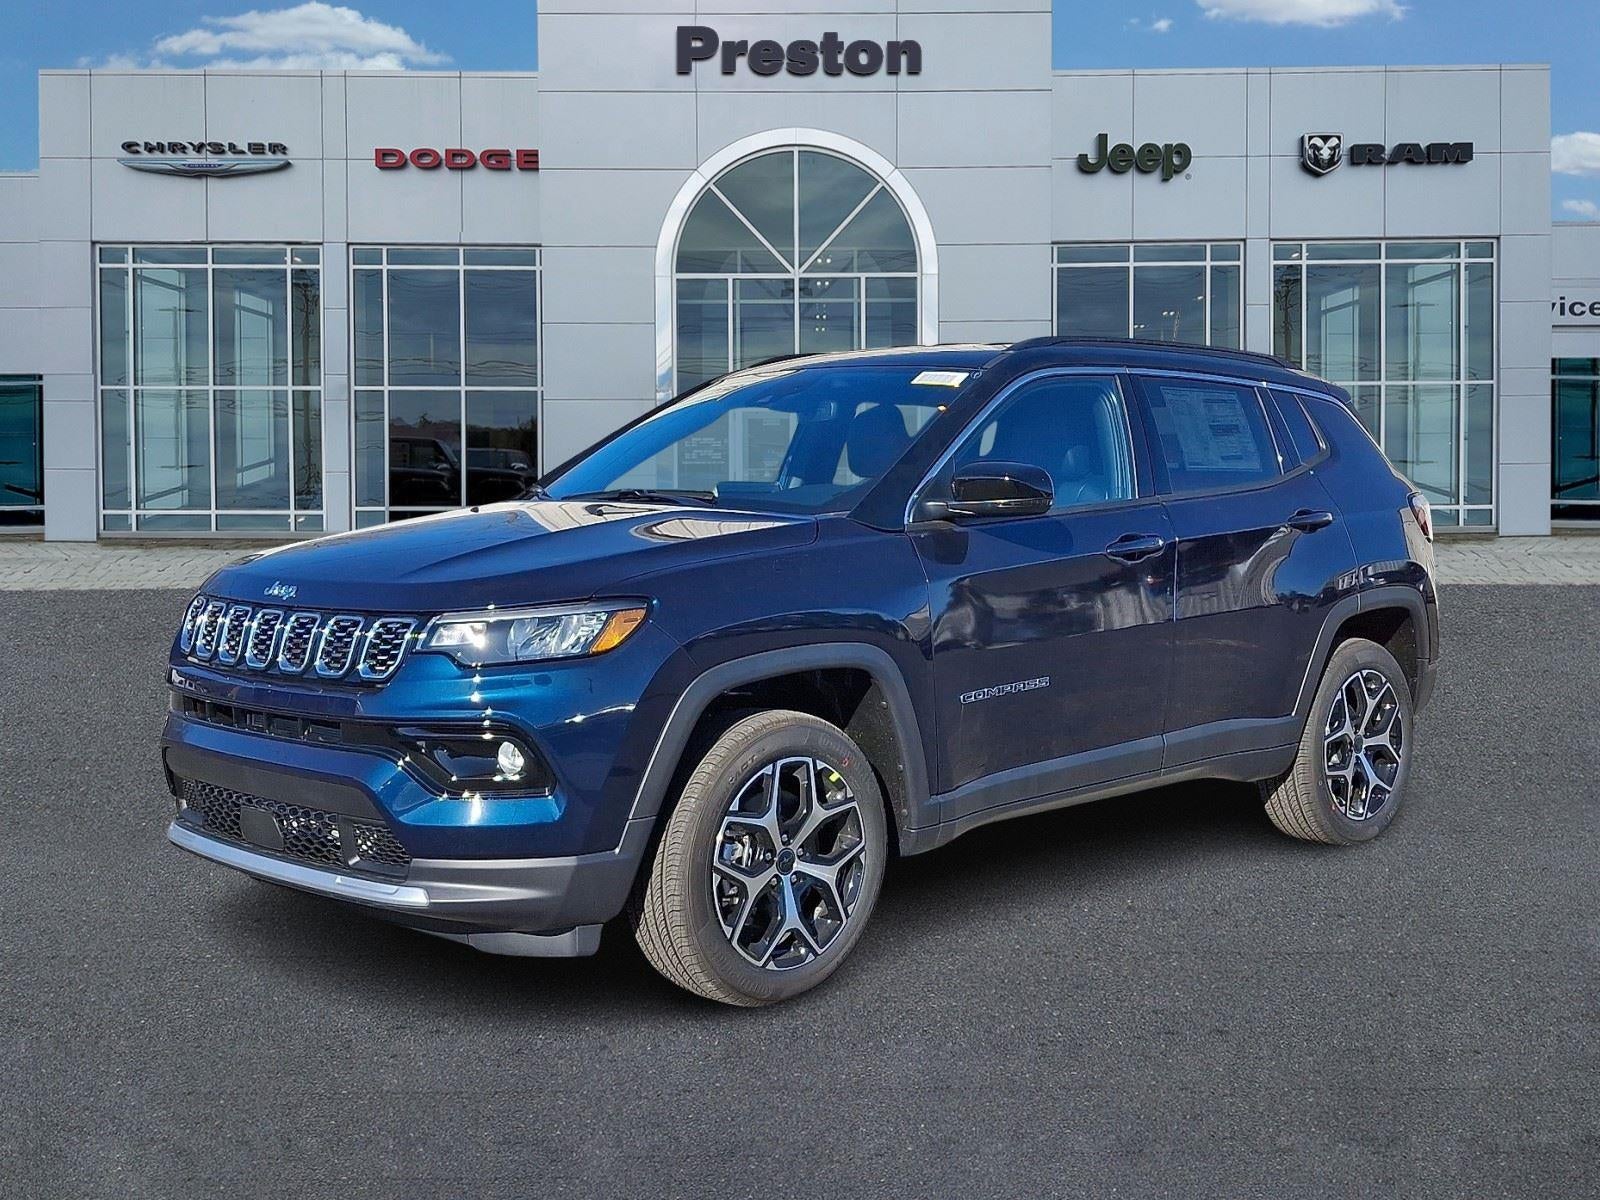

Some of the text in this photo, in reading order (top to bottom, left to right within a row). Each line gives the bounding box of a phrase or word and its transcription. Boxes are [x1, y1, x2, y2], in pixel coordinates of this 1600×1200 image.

[676, 26, 922, 76] Preston
[121, 141, 288, 155] CHRYSLER
[375, 148, 539, 171] DODGE
[1078, 133, 1192, 182] Jeep
[1350, 142, 1473, 165] RAM
[1552, 296, 1600, 316] ice
[960, 676, 1050, 704] COMPASS
